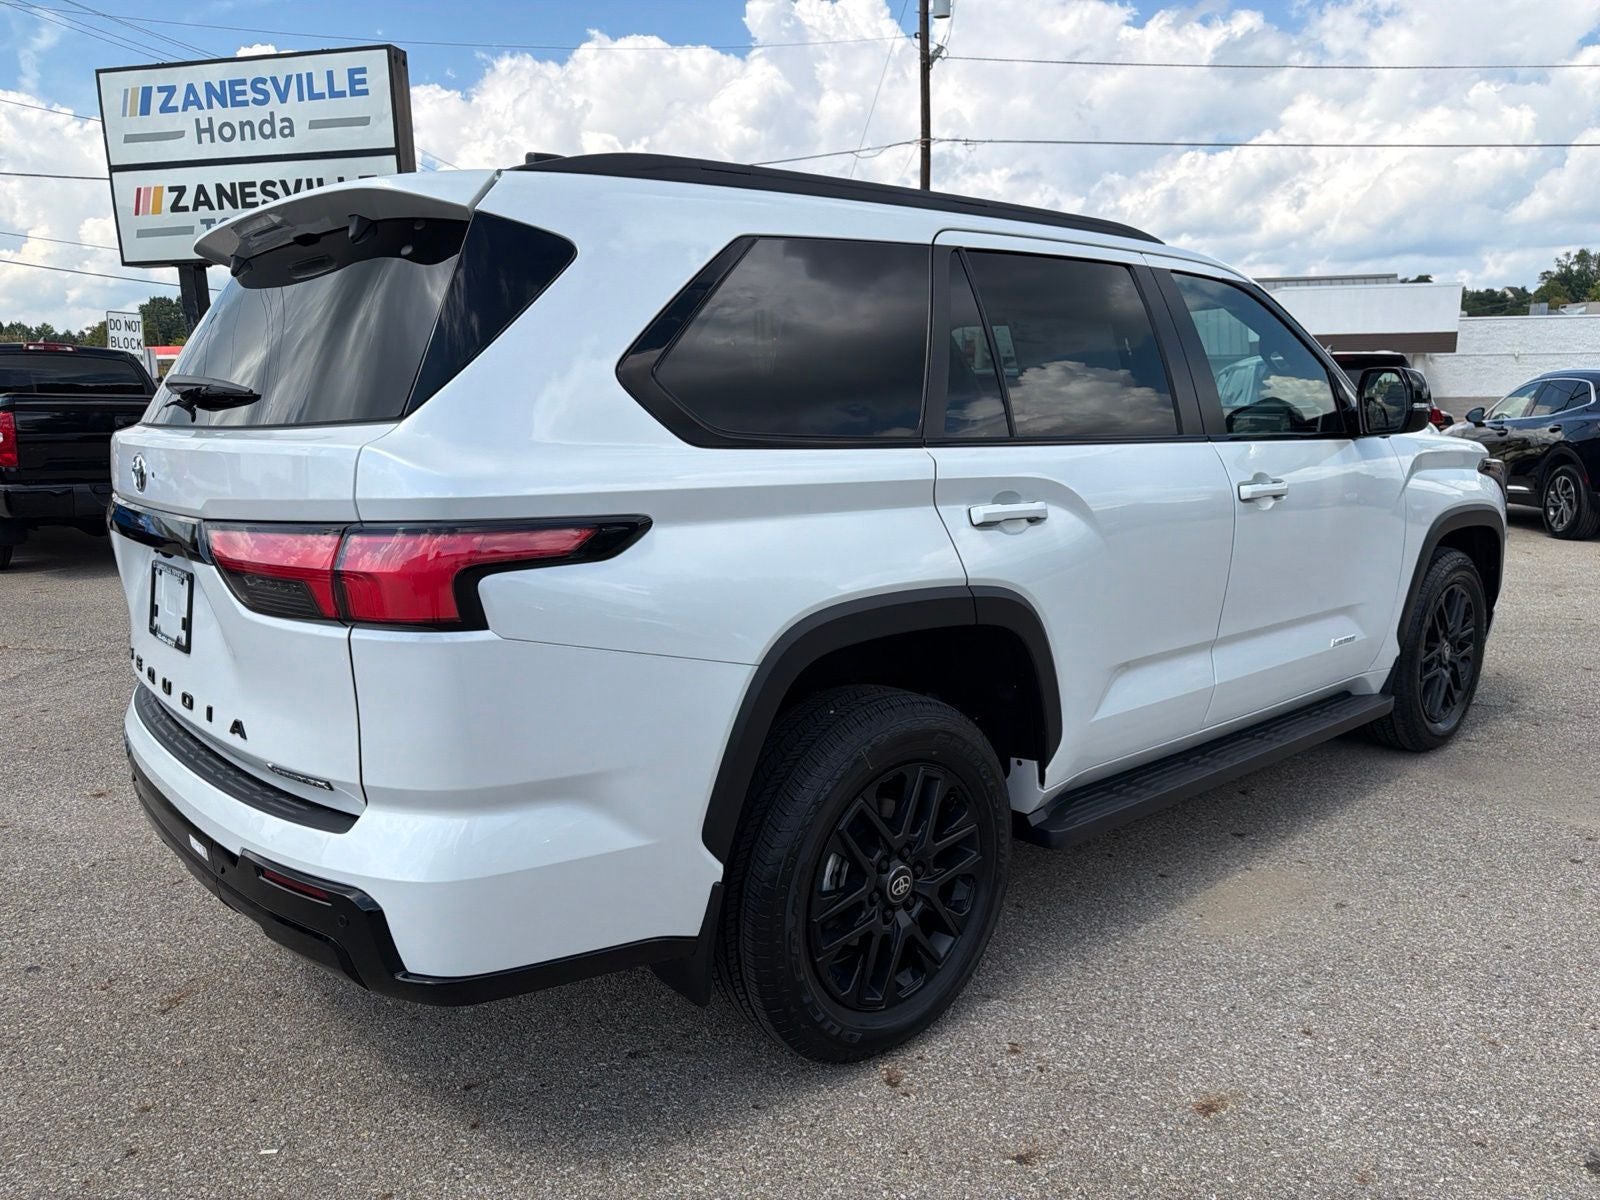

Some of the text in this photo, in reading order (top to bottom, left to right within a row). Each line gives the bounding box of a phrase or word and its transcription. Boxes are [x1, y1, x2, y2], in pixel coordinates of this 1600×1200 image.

[157, 67, 369, 114] ZANESVILLE
[194, 111, 295, 144] Honda
[168, 175, 377, 213] ZANESV
[109, 318, 142, 333] DO NOT
[110, 336, 143, 350] BLOCK
